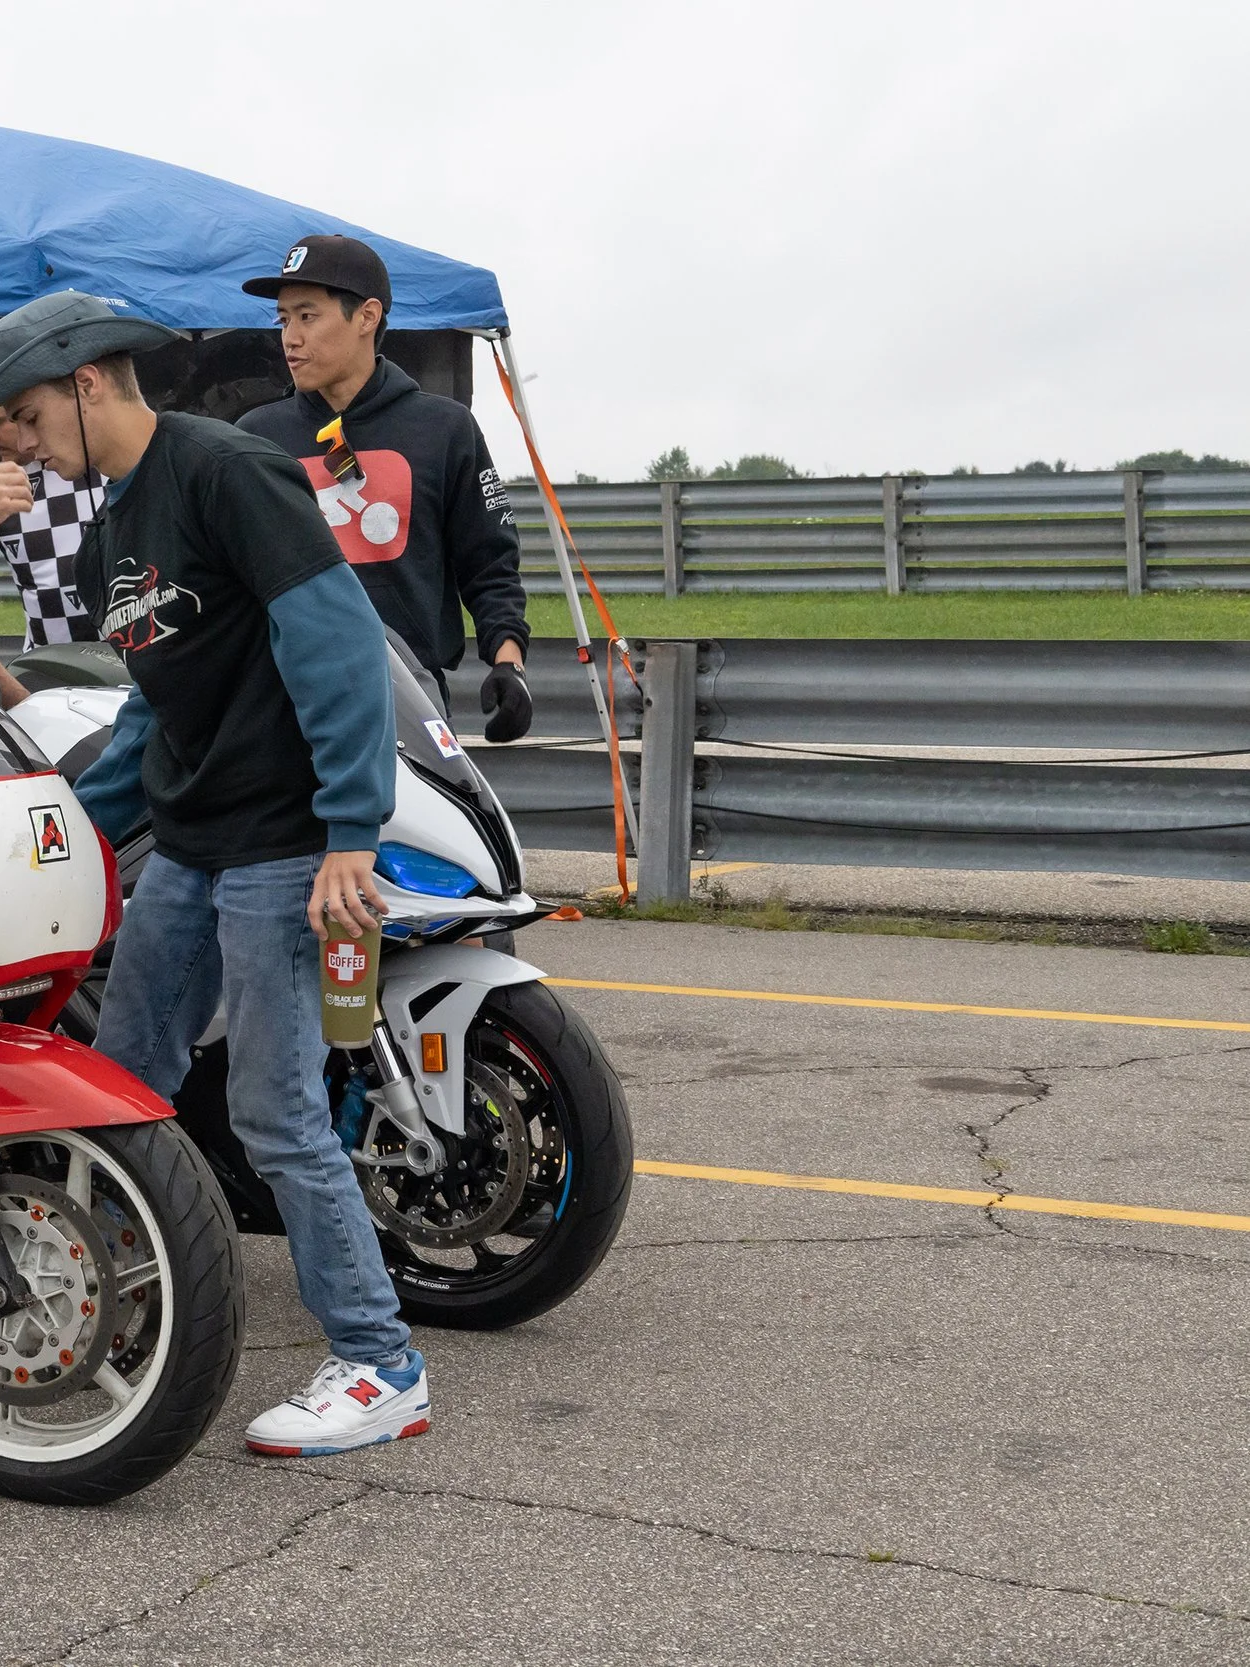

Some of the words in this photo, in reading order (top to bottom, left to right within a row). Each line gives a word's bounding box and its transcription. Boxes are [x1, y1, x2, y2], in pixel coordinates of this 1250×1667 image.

[330, 955, 364, 968] COFFEE
[334, 995, 351, 1003] BLACK
[352, 995, 367, 1003] RIFLE
[403, 1274, 418, 1284] BMW
[418, 1279, 450, 1290] MOTORRAD
